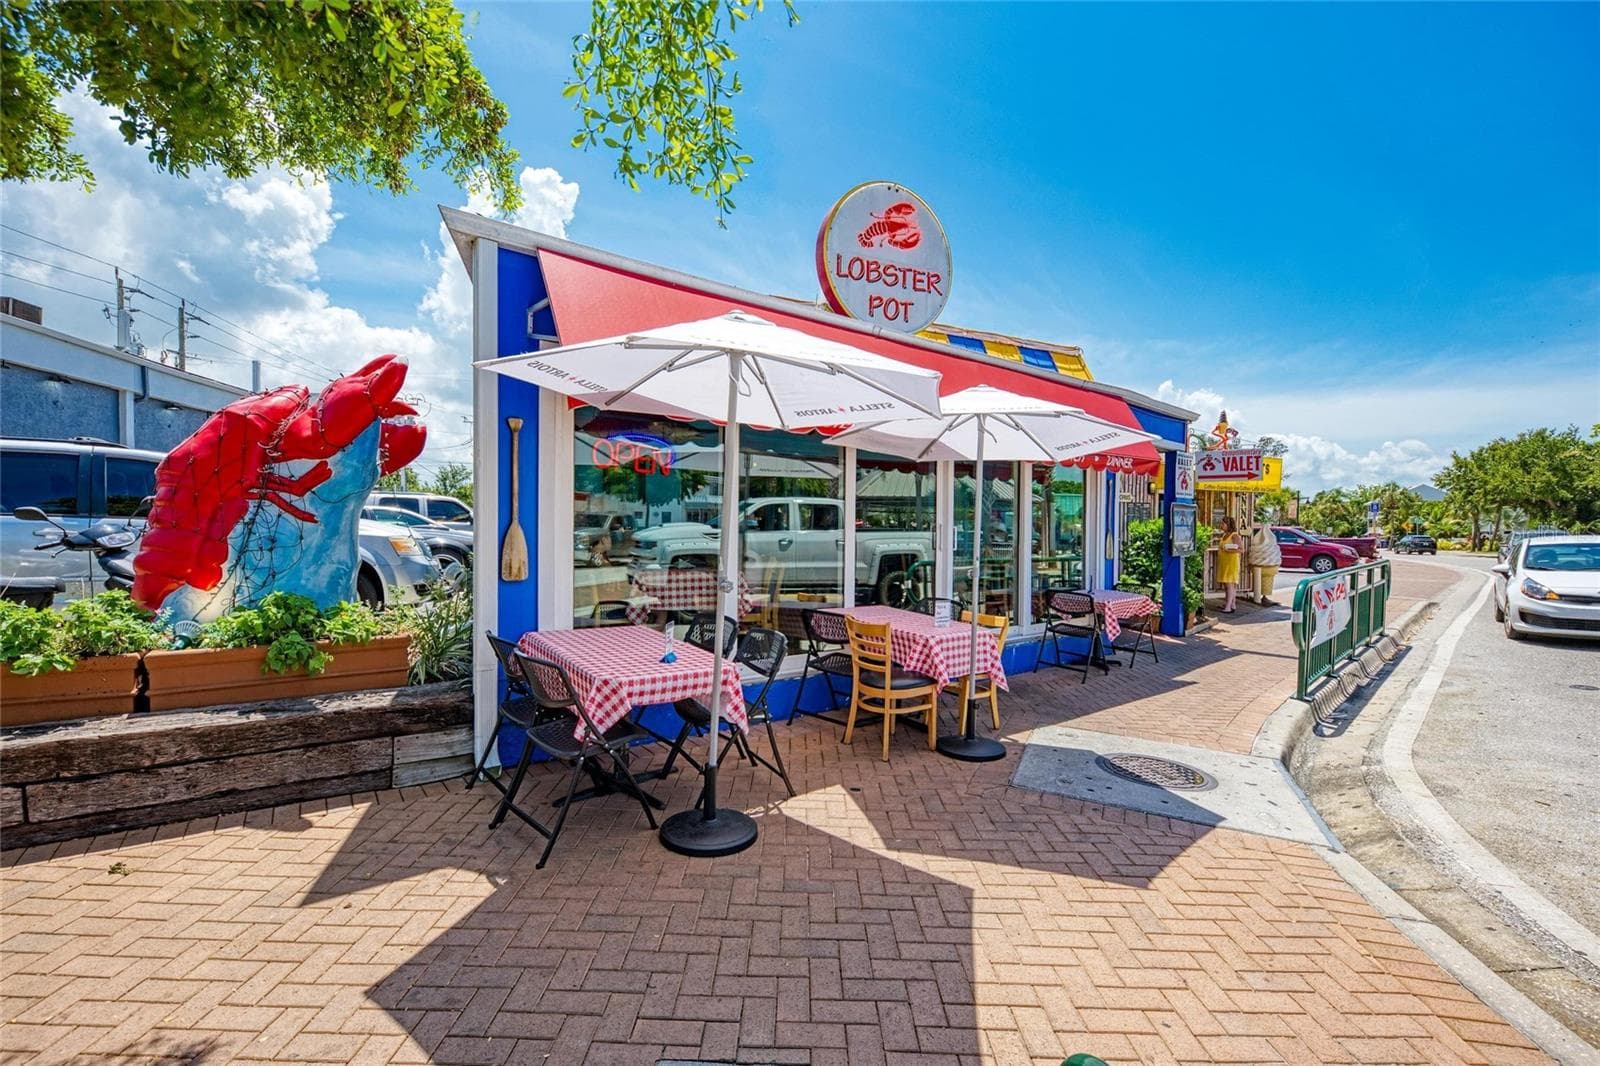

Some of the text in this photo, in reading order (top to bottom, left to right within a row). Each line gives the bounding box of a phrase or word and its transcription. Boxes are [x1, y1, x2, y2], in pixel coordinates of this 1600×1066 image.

[836, 253, 943, 296] LOBSTER
[868, 294, 914, 323] POT
[592, 439, 672, 476] OPEN
[1107, 456, 1134, 469] DINNER
[1222, 455, 1261, 472] VALET
